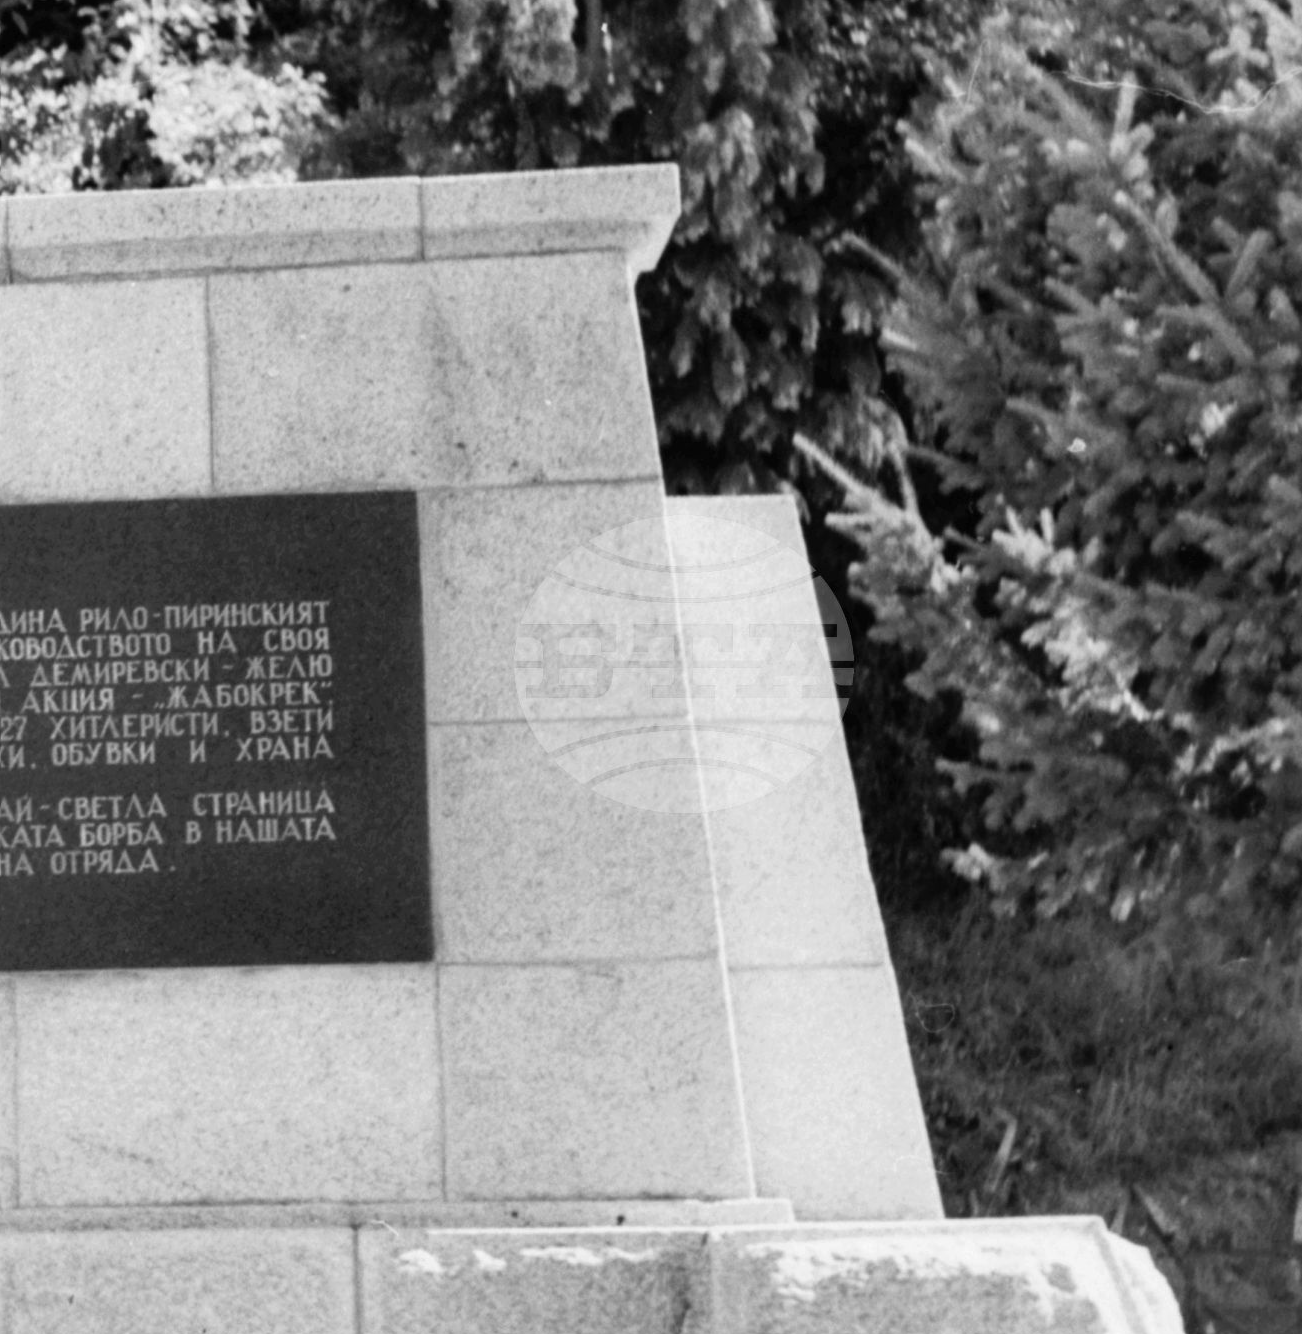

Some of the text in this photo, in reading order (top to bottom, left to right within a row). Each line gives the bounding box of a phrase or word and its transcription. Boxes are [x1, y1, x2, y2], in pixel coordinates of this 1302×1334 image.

[79, 601, 330, 632] РИЛО-ПИРИНСКИЯТ
[196, 629, 238, 655] НА
[262, 627, 331, 652] СВОЯ
[29, 657, 210, 687] ДЕМИРЕВСКИ
[244, 653, 334, 679] ЖЕЛЮ
[20, 687, 115, 714] АКЦИЯ
[0, 715, 28, 742] 27
[249, 708, 334, 734] ВЗЕТИ
[50, 741, 156, 766] ОБУВКИ
[189, 740, 207, 763] И
[235, 734, 335, 761] ХРАНА
[191, 789, 336, 816] СТРАНИЦА
[78, 821, 165, 848] БОРБА
[184, 820, 203, 844] В
[215, 816, 337, 844] НАШАТА
[49, 848, 177, 874] ОТРЯДА.
